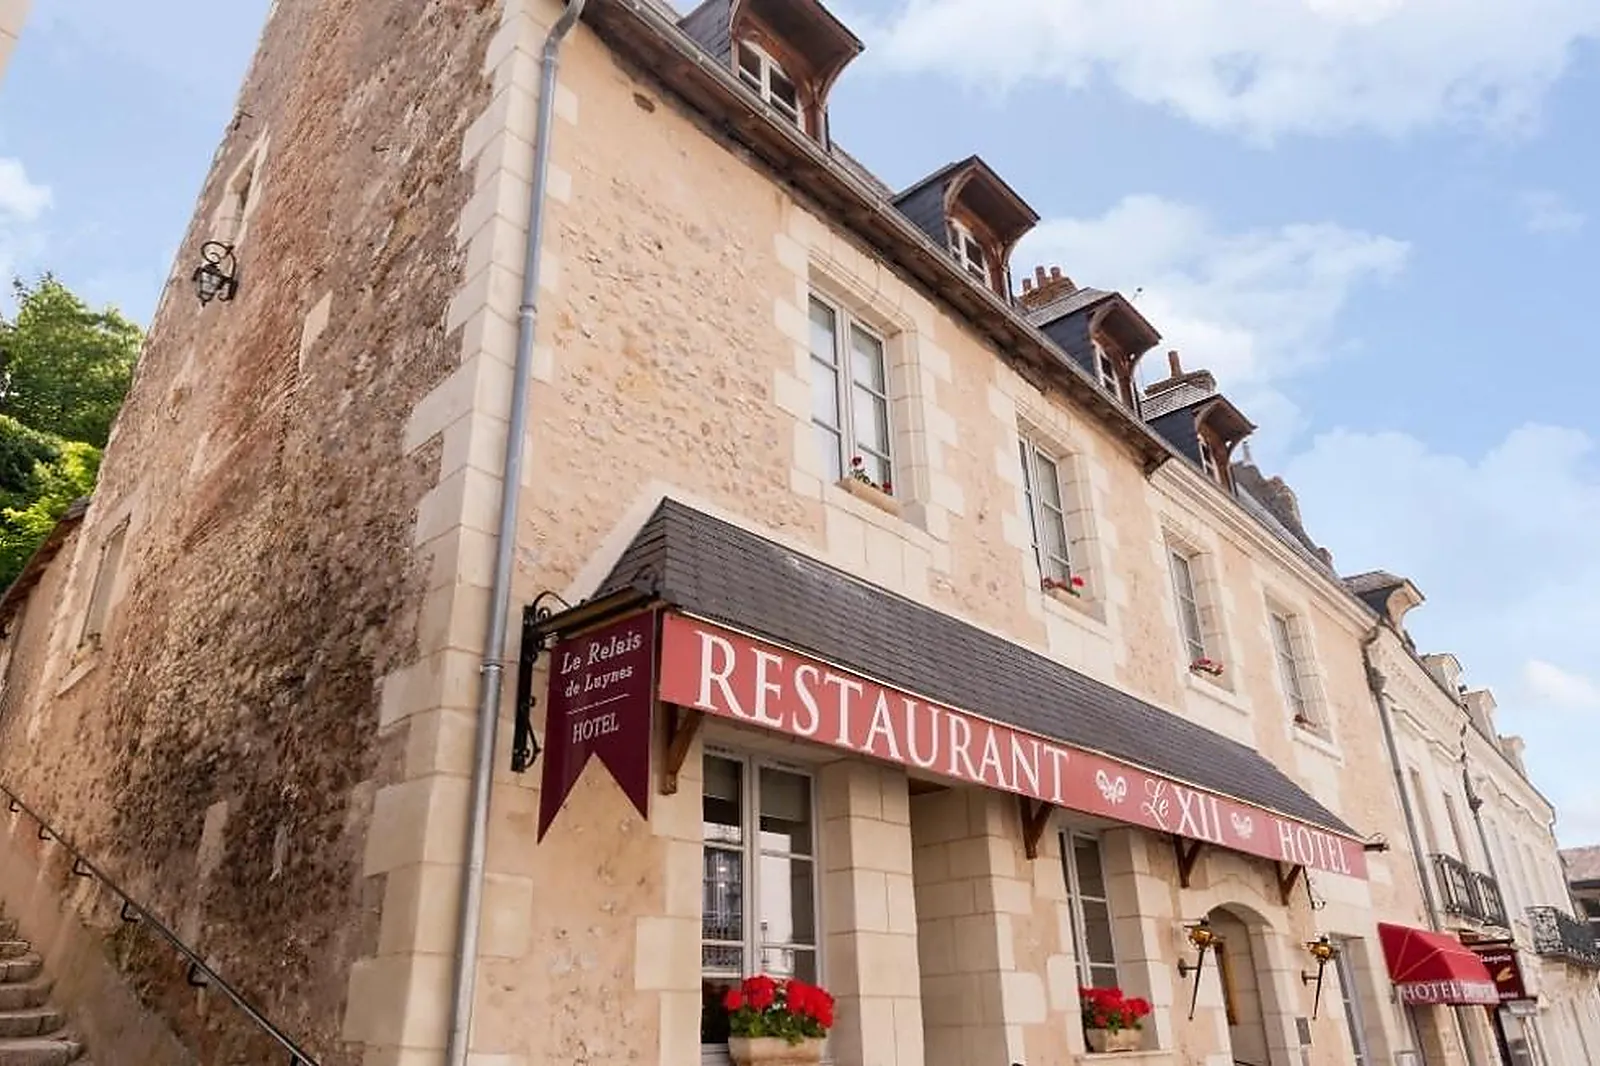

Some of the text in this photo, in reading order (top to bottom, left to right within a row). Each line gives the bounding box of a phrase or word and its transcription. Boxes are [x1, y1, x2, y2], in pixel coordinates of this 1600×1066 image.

[561, 631, 642, 675] Le Relais
[565, 666, 633, 698] de Luynes
[573, 712, 620, 744] HOTEL
[693, 630, 1351, 875] RESTAURANT Le XII HOTEL
[1402, 980, 1462, 1002] HOTEL
